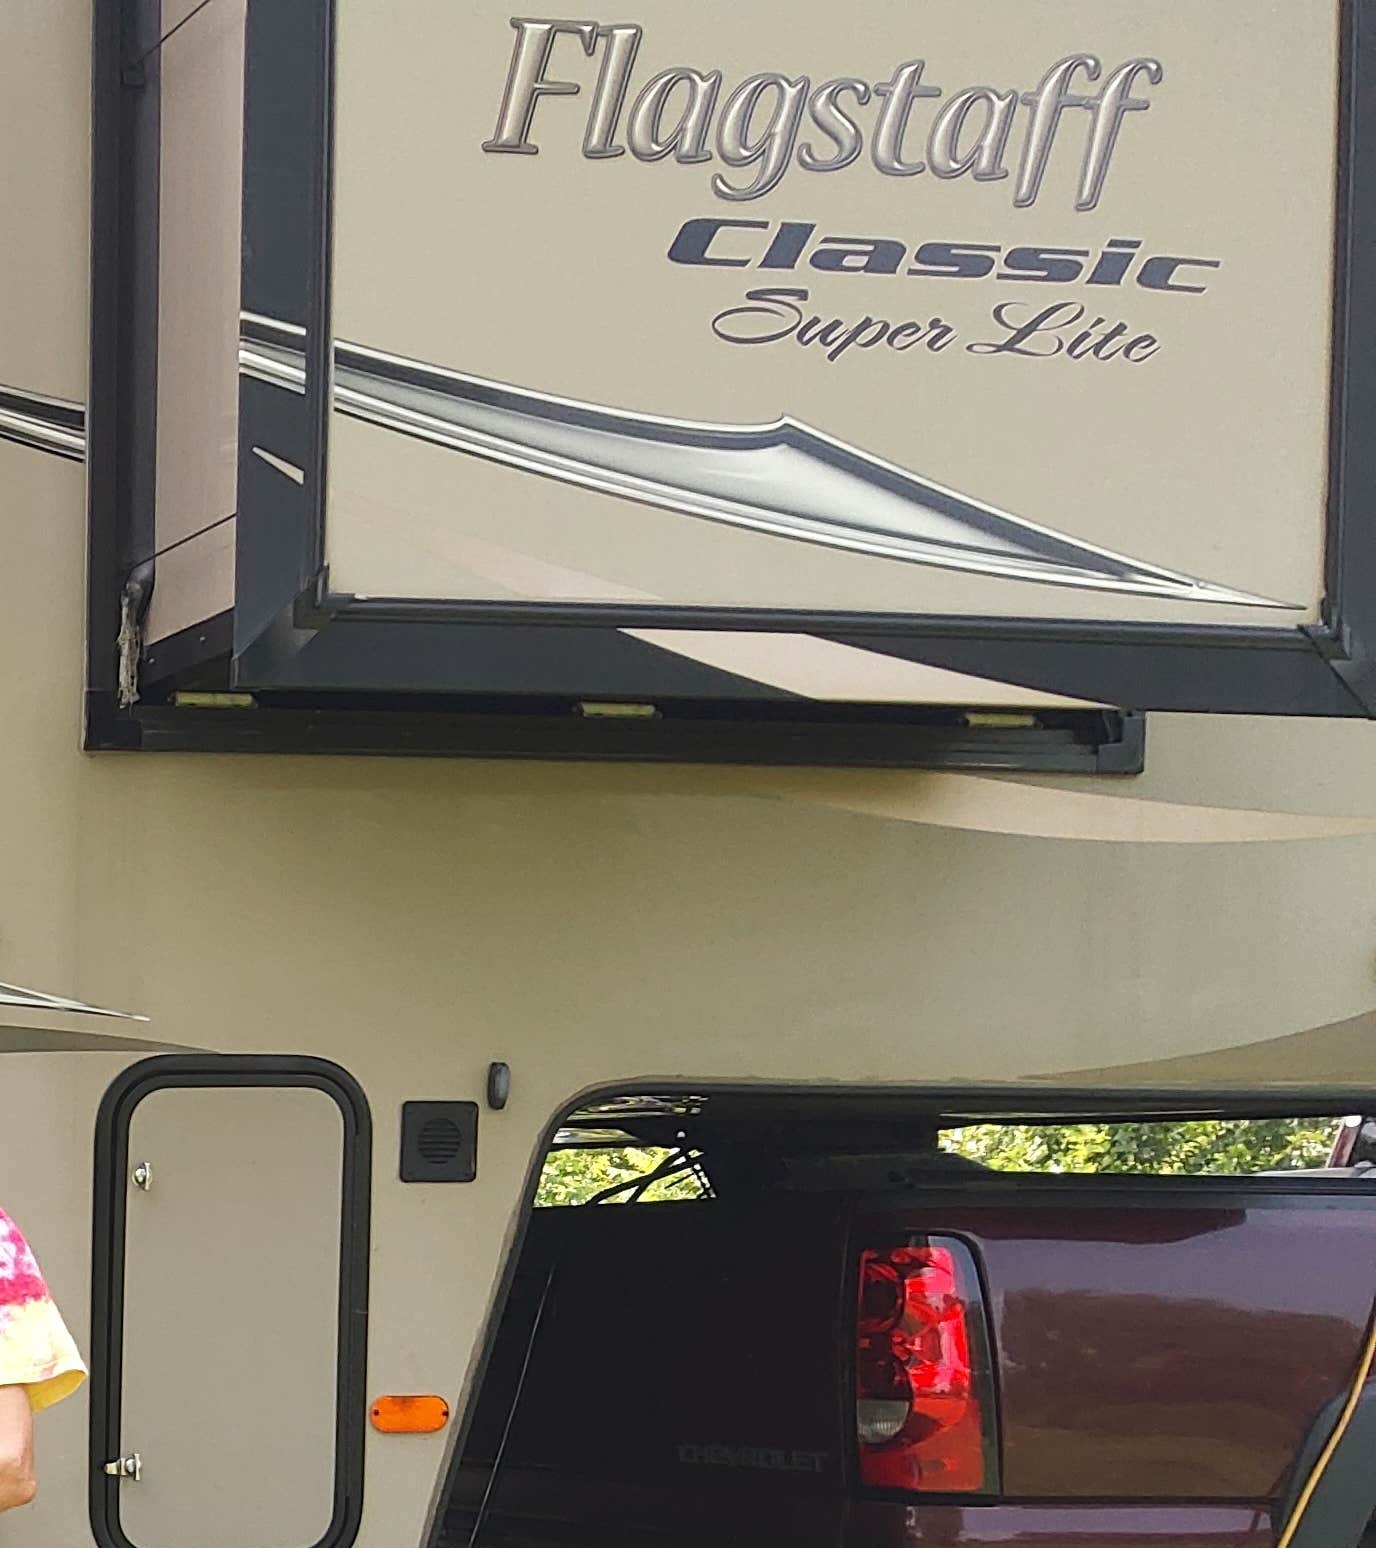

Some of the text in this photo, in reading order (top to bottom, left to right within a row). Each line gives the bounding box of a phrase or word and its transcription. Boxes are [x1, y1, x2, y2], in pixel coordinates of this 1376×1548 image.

[482, 16, 1163, 211] Flagstaff
[666, 217, 1221, 294] Classic
[711, 288, 1162, 363] Super Lite
